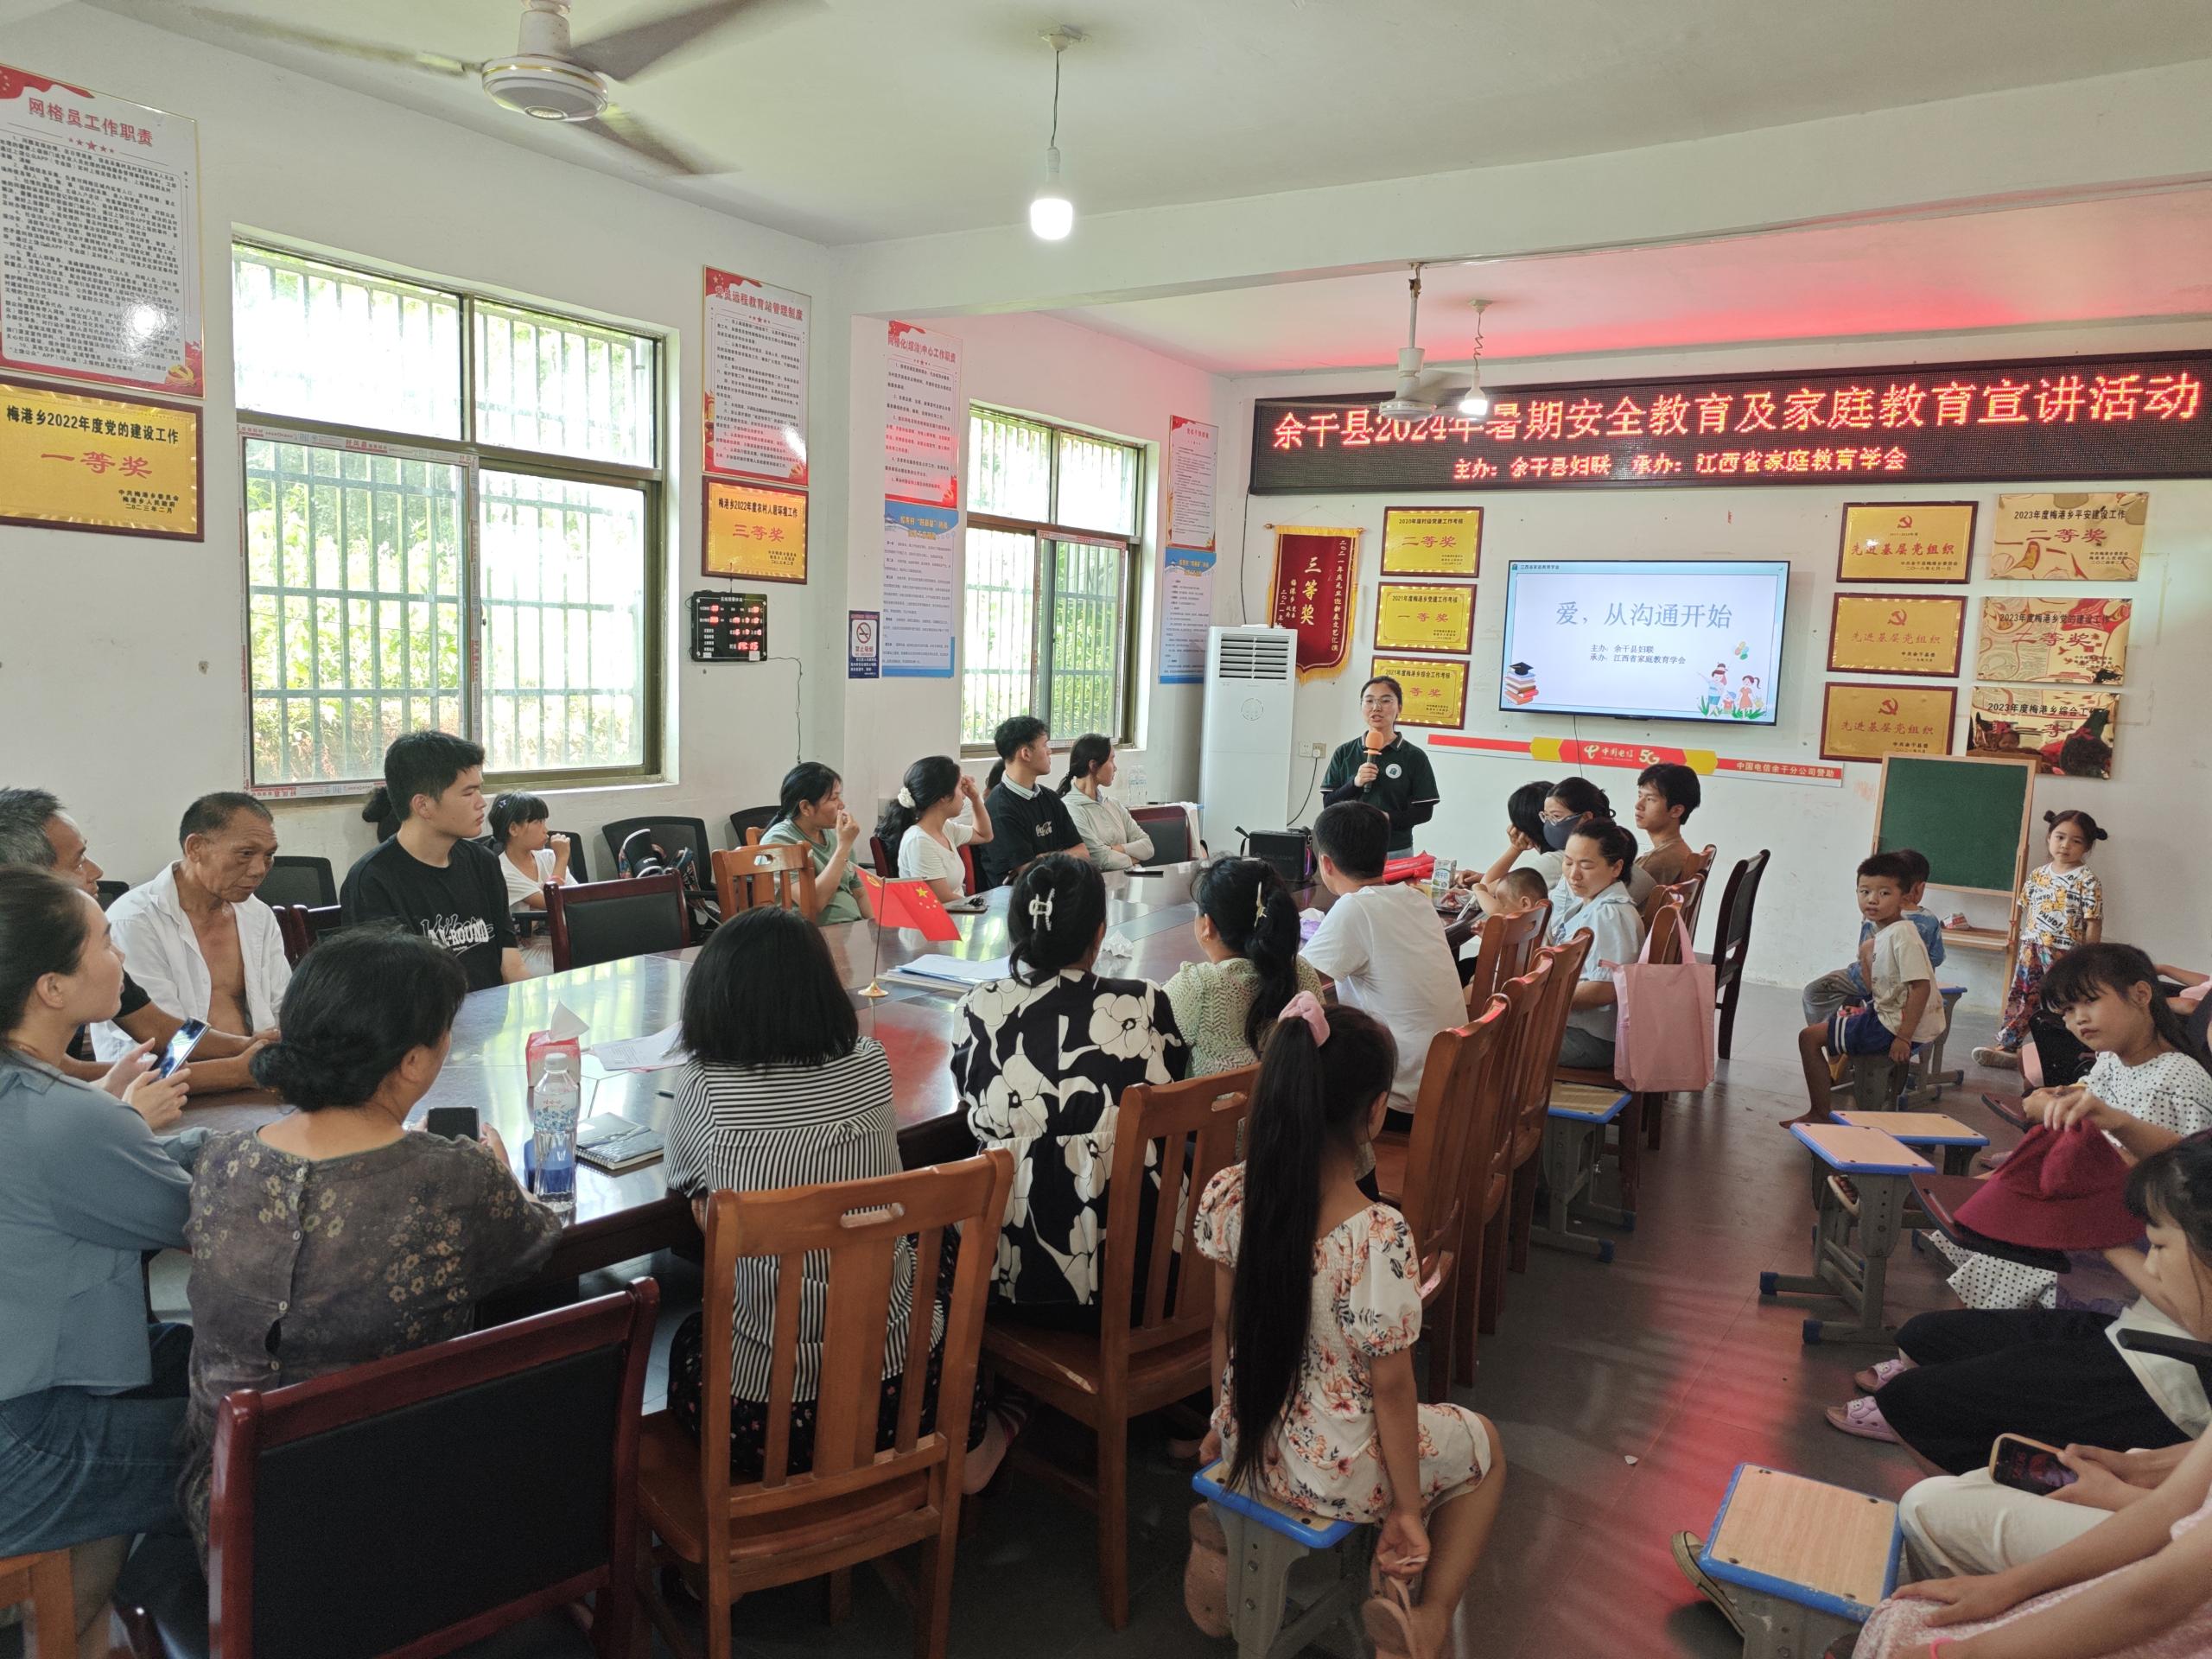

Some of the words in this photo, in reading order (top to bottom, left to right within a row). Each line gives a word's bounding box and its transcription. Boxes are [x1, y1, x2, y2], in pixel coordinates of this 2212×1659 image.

[29, 97, 154, 147] 网格员工作职责
[1274, 373, 2201, 449] 余干县2024年暑期安全教育及家庭教育宣讲活动
[6, 404, 178, 444] 梅港乡2022年度党的建设工作
[41, 451, 153, 479] 一等奖
[2014, 510, 2126, 520] 2023年度梅港乡平安建设工作
[733, 524, 785, 543] 三等奖
[2026, 529, 2107, 543] 二等奖
[1402, 535, 1458, 548] 二等奖
[1852, 542, 1955, 556] 先进基层党组织
[1300, 556, 1322, 626] 三等奖
[1397, 613, 1448, 623] 一等奖
[1555, 601, 1732, 629] 爱，从沟通开始
[1852, 631, 1941, 645] 先进基层党组织
[2012, 632, 2092, 647] 二等奖
[1409, 687, 1442, 698] 等奖
[1841, 720, 1935, 734] 先进基层党组织
[1639, 749, 1661, 765] 5G
[1736, 761, 1835, 778] 中国电信余干分公司赞助
